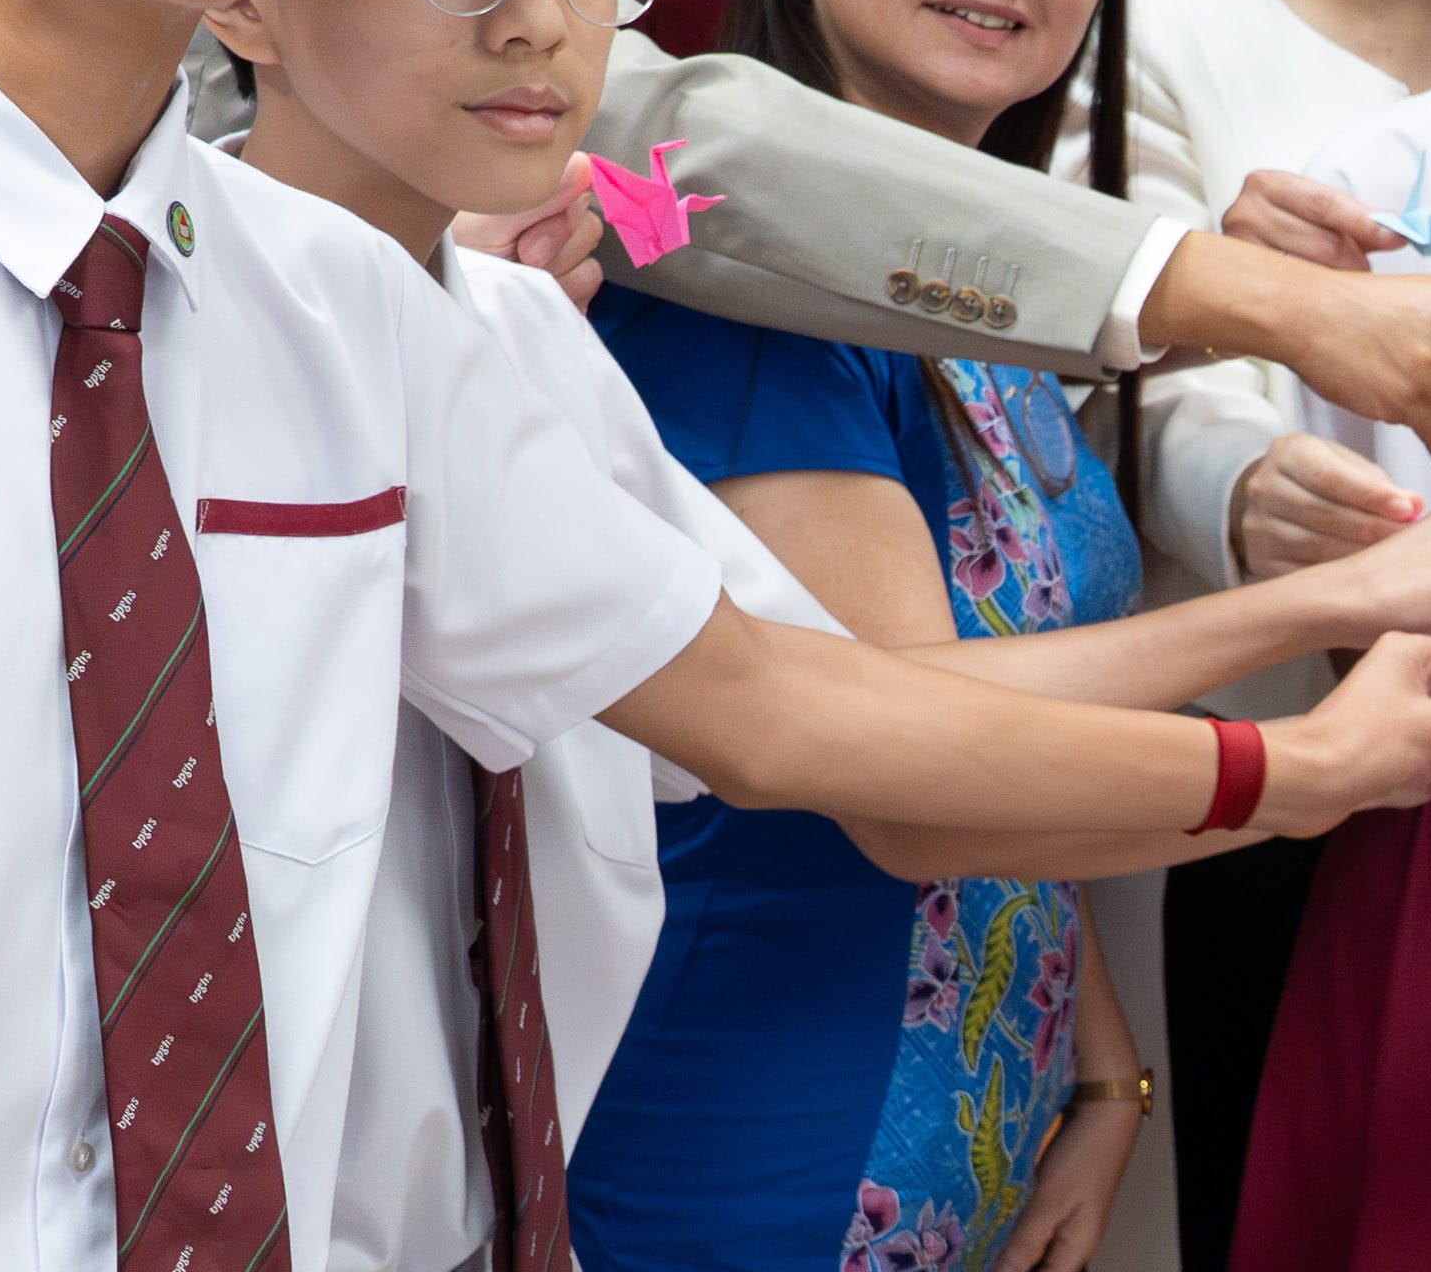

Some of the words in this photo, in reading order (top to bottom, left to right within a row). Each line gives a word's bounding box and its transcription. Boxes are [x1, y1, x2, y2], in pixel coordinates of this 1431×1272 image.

[84, 360, 112, 388] bpghs
[150, 528, 170, 560] bpghs
[109, 590, 136, 621] bpghs
[173, 757, 196, 788] bpghs
[132, 818, 157, 849] bpghs
[89, 879, 115, 912] bpghs
[228, 912, 247, 942] bpghs
[189, 973, 212, 1003] bpghs
[151, 1034, 174, 1065] bpghs
[117, 1097, 139, 1129] bpghs
[246, 1121, 266, 1152] bpghs
[209, 1183, 232, 1214] bpghs
